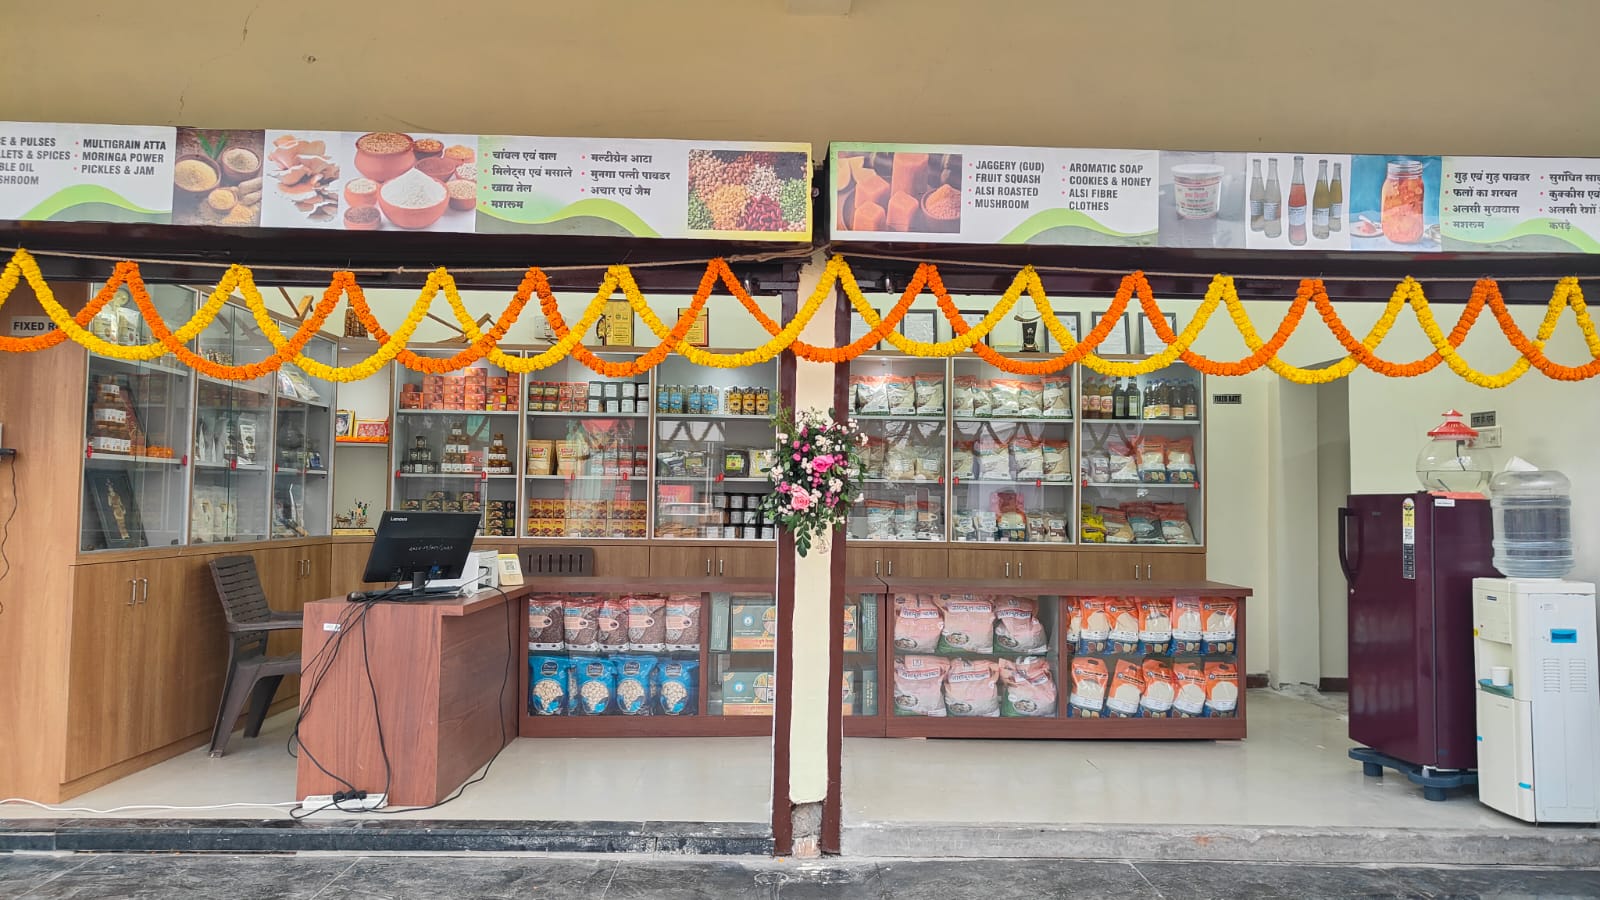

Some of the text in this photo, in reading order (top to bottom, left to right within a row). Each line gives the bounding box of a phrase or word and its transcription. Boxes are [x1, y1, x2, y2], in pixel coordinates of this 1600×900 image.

[0, 136, 56, 147] E & PULSES
[82, 138, 166, 150] MULTIGRAIN ATTA
[0, 150, 71, 160] LETS & SPICES
[82, 152, 164, 163] MORINGA POWER
[522, 149, 536, 161] एवं
[538, 152, 557, 160] दाल
[630, 154, 652, 163] आटा
[19, 162, 34, 172] OIL
[81, 164, 154, 176] PICKLES & JAM
[528, 166, 542, 178] एवं
[544, 166, 573, 178] मसाले
[976, 160, 1044, 173] JAGGERY (GUD)
[1069, 163, 1144, 174] AROMATIC SOAP
[590, 170, 616, 182] मुनगा
[642, 171, 671, 180] पावडर
[976, 173, 1041, 184] FRUIT SQUASH
[1069, 176, 1152, 186] COOKIES & HONEY
[1470, 170, 1484, 182] एवं
[1502, 173, 1530, 182] पावडर
[516, 181, 532, 192] तेल
[590, 186, 616, 195] अचार
[618, 184, 632, 196] एवं
[975, 186, 1039, 196] ALSI ROASTED
[1452, 186, 1518, 198] फलों का शरबत
[1069, 188, 1118, 198] ALSI FIBRE
[491, 200, 524, 209] मशरूम
[975, 198, 1029, 209] MUSHROOM
[1069, 201, 1110, 210] CLOTHES
[1452, 202, 1481, 213] अलसी
[1548, 203, 1578, 214] अलसी
[1452, 221, 1485, 229] मशरूम
[13, 322, 58, 331] FIXED R
